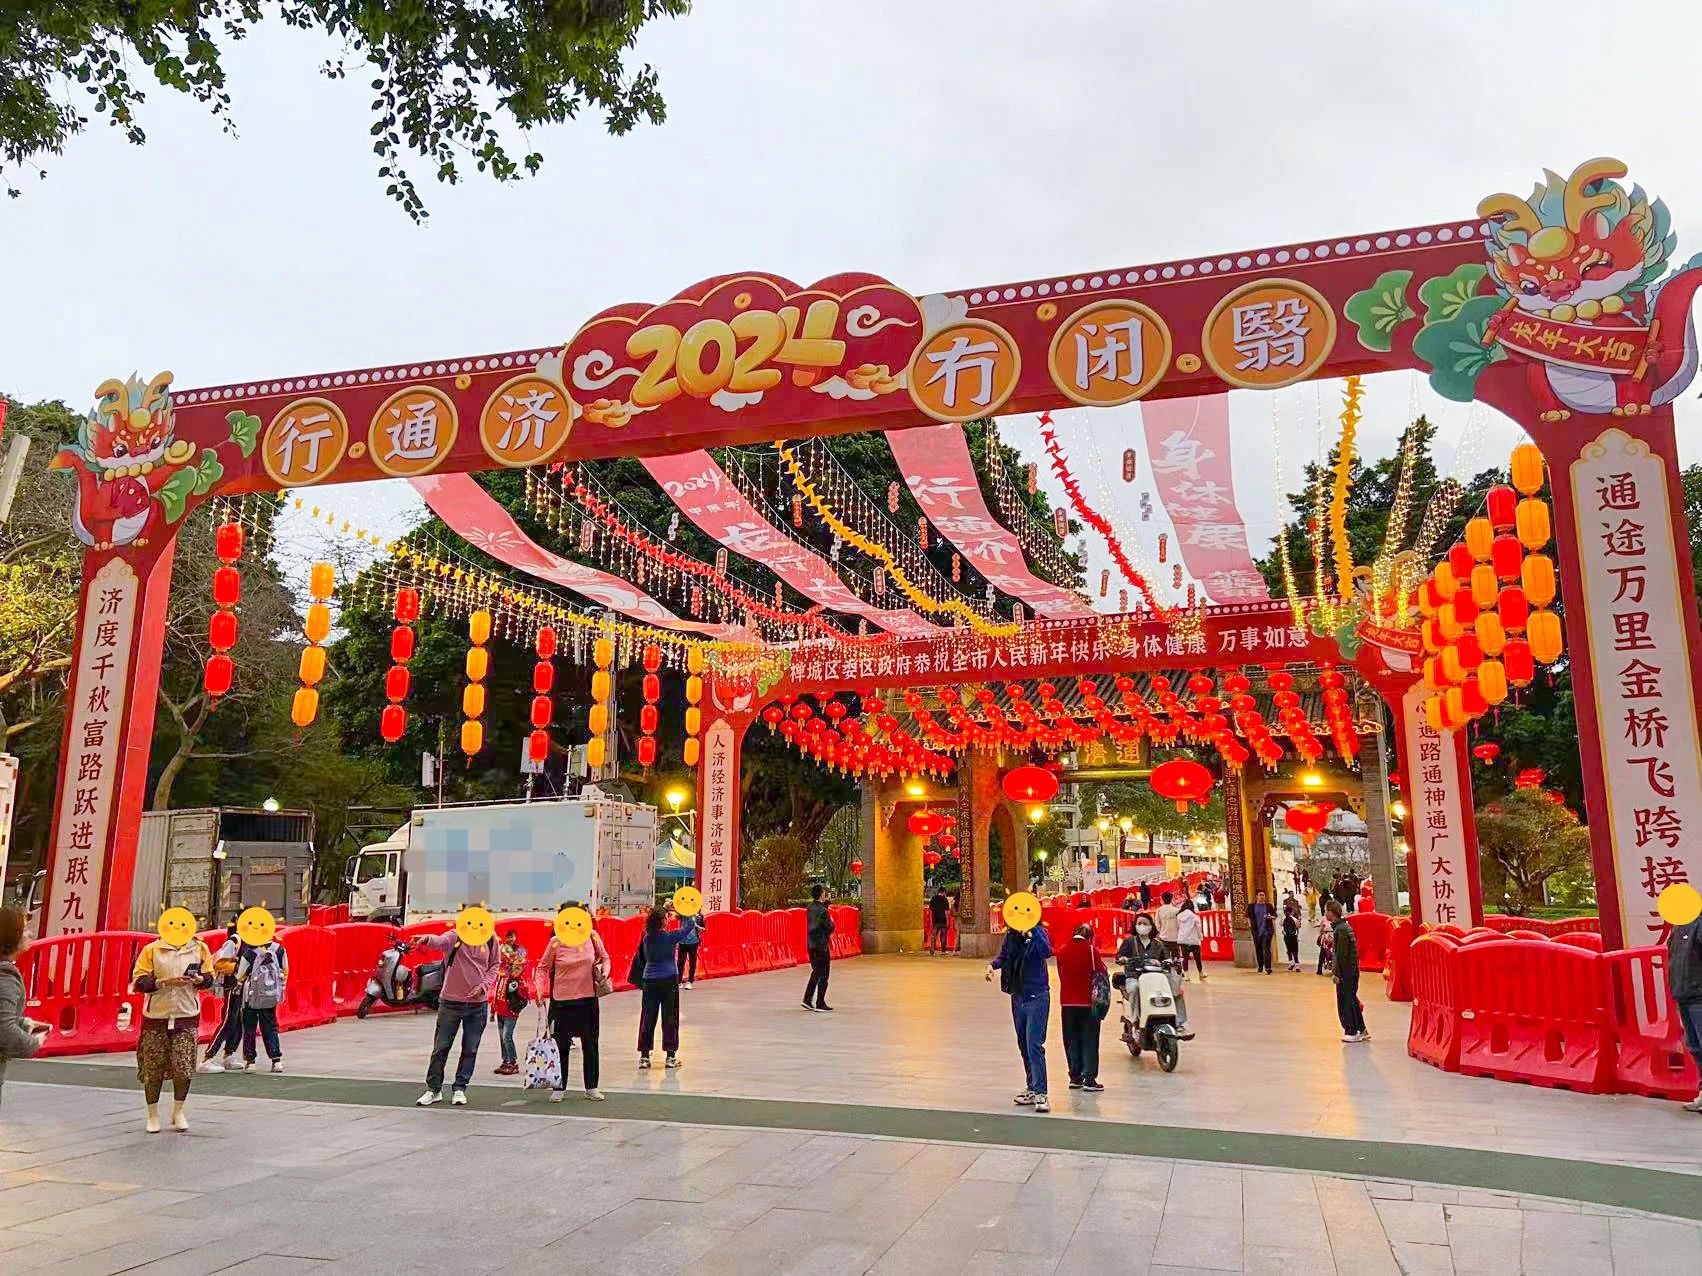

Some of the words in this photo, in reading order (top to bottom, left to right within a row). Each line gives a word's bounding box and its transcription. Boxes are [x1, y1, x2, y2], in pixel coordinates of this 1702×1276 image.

[275, 390, 560, 475] 行通济
[626, 300, 846, 405] 2024
[925, 298, 1313, 407] 冇闭翳
[664, 468, 722, 498] 2024
[1218, 625, 1309, 652] 万事如意
[61, 587, 120, 934] 济度千秋富路跃进联九
[708, 734, 726, 911] 人济经济事济宽宏和谐
